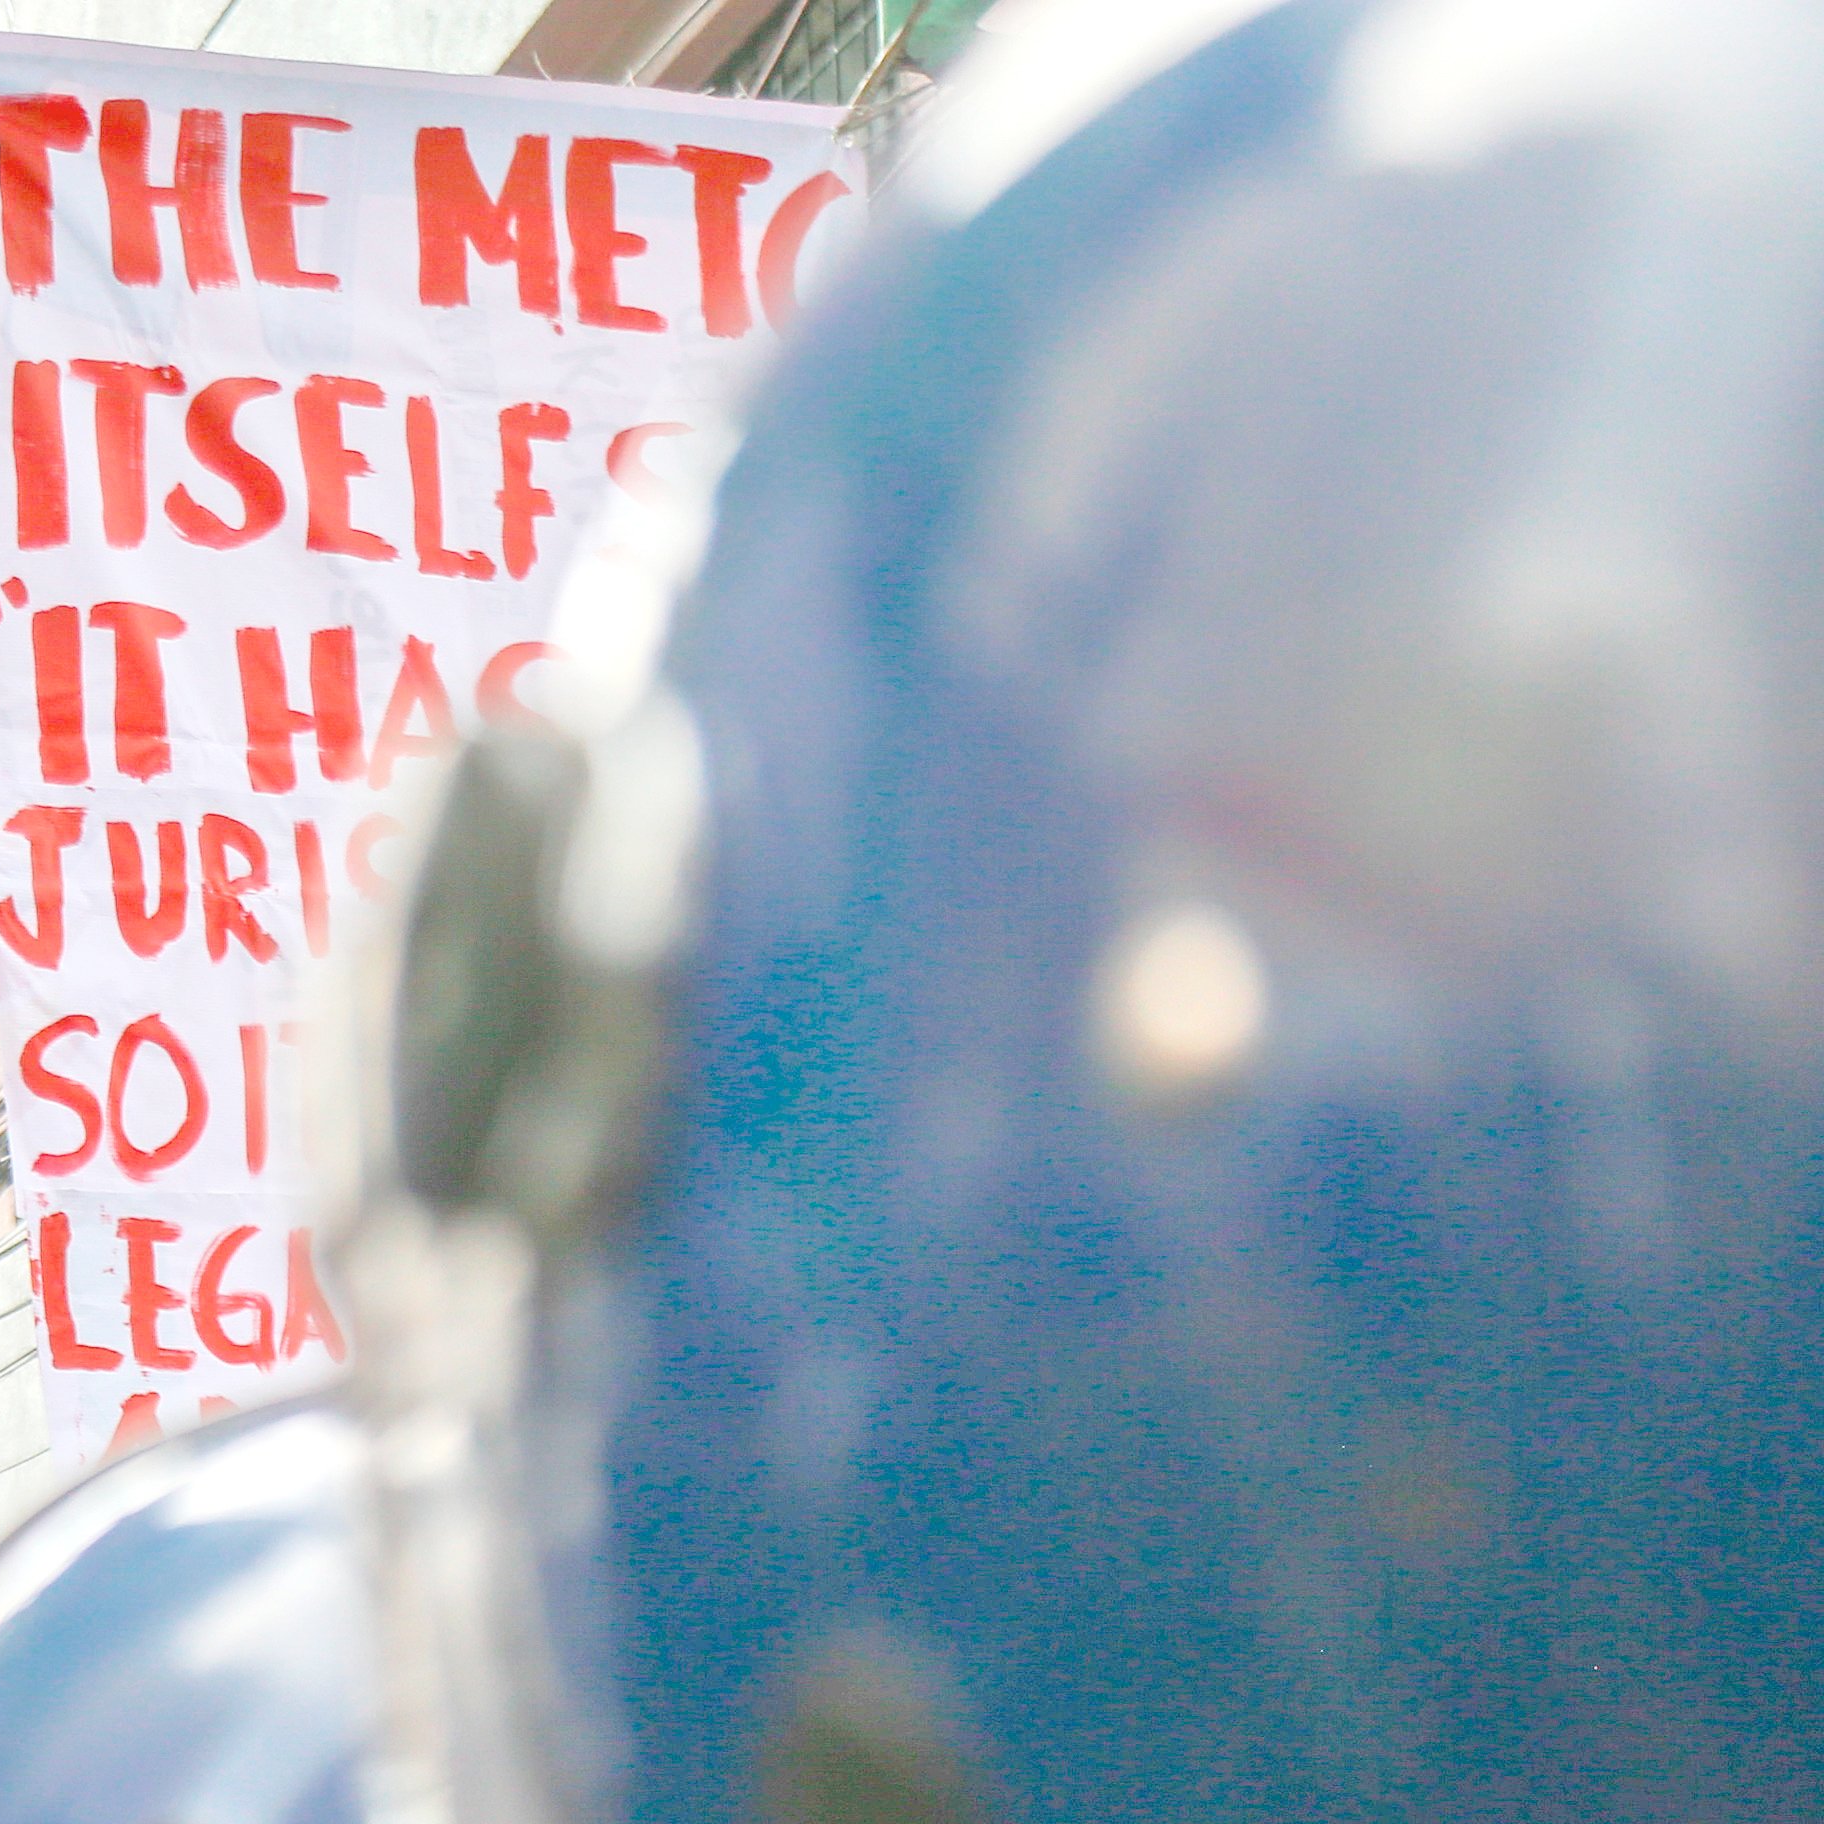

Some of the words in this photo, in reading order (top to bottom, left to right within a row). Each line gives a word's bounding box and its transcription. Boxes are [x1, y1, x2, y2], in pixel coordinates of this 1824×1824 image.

[11, 357, 572, 581] ITSELF
[19, 1013, 210, 1183] SO
[40, 1211, 348, 1371] LEGA
